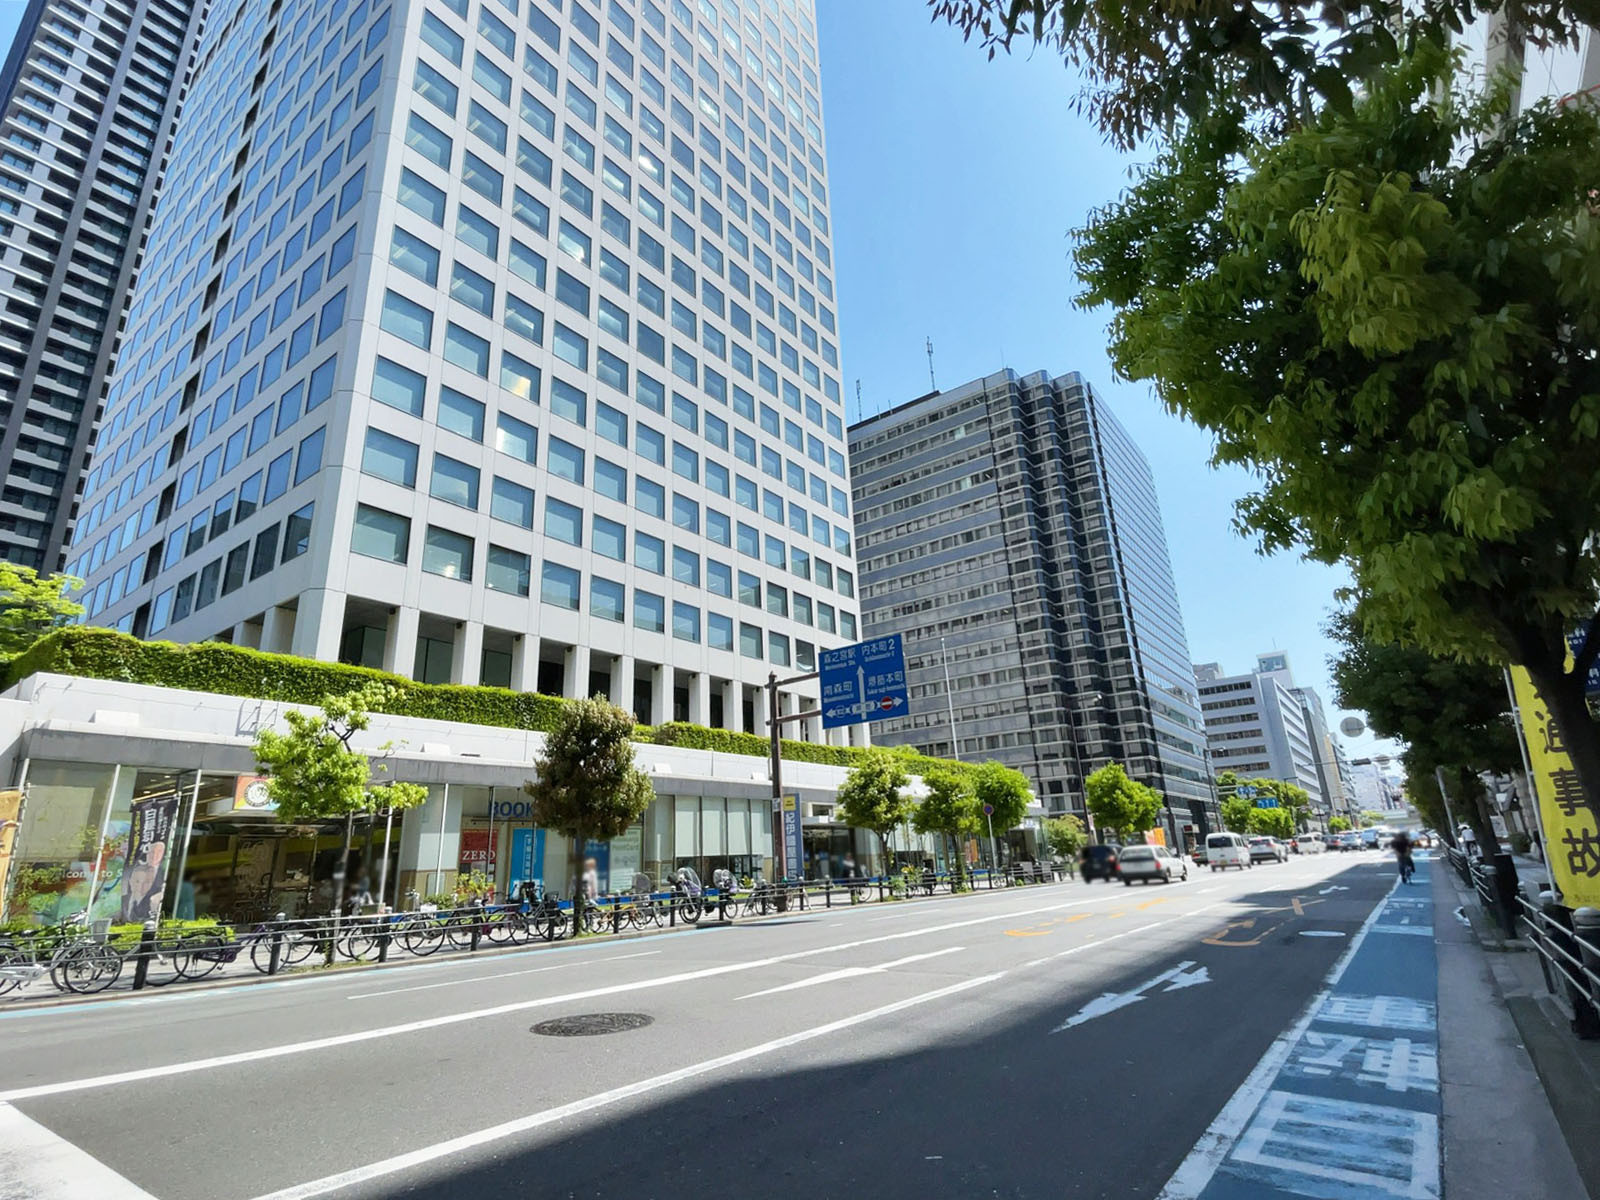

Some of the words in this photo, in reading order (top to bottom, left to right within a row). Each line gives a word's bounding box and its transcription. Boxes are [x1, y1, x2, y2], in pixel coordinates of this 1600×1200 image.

[1529, 681, 1600, 877] 通事故
[462, 850, 496, 861] ZERO
